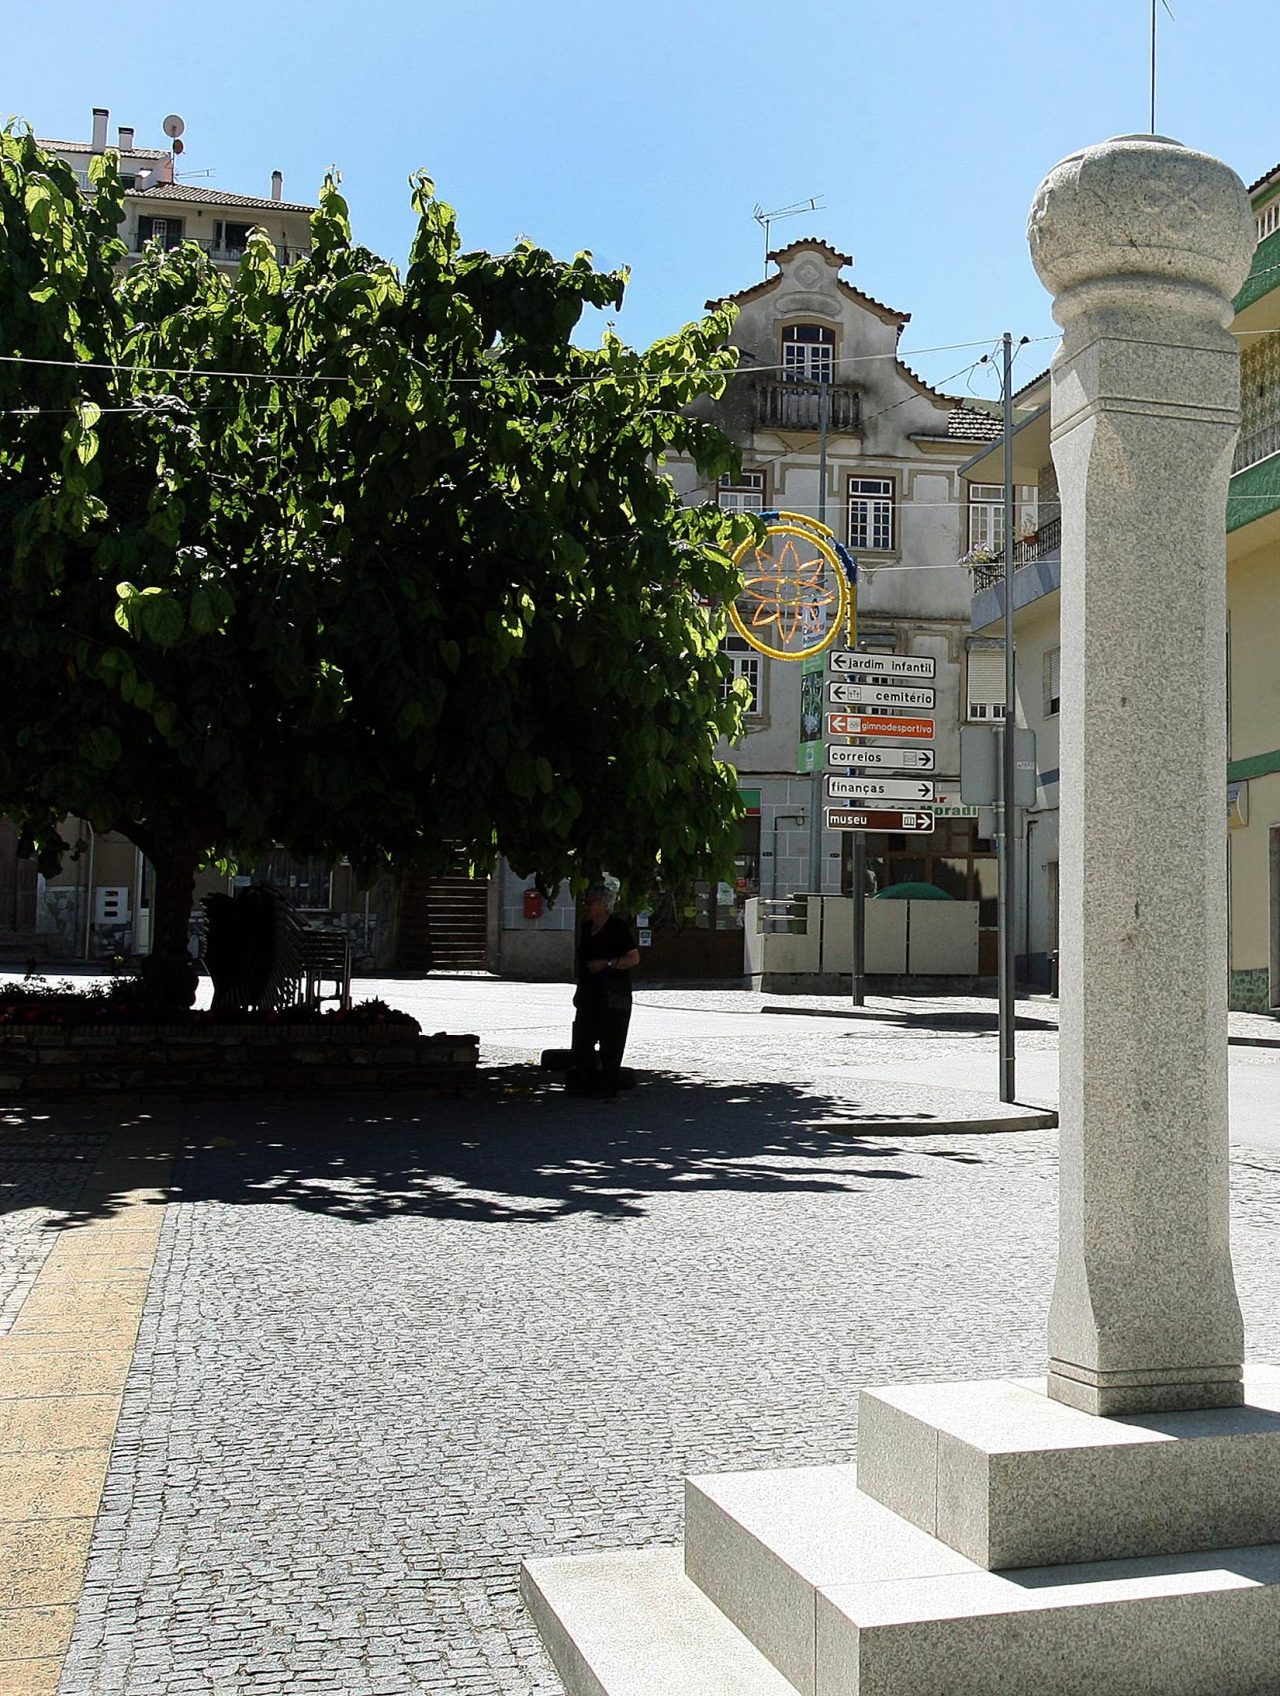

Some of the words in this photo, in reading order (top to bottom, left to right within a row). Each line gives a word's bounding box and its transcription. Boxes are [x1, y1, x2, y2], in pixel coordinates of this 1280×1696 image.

[848, 657, 884, 670] jardim
[891, 660, 932, 674] infantil
[875, 690, 932, 704] cemitério
[861, 722, 932, 734] gimnodesportivo
[831, 751, 882, 763] correios
[830, 781, 885, 796] finanças
[829, 814, 868, 825] museu
